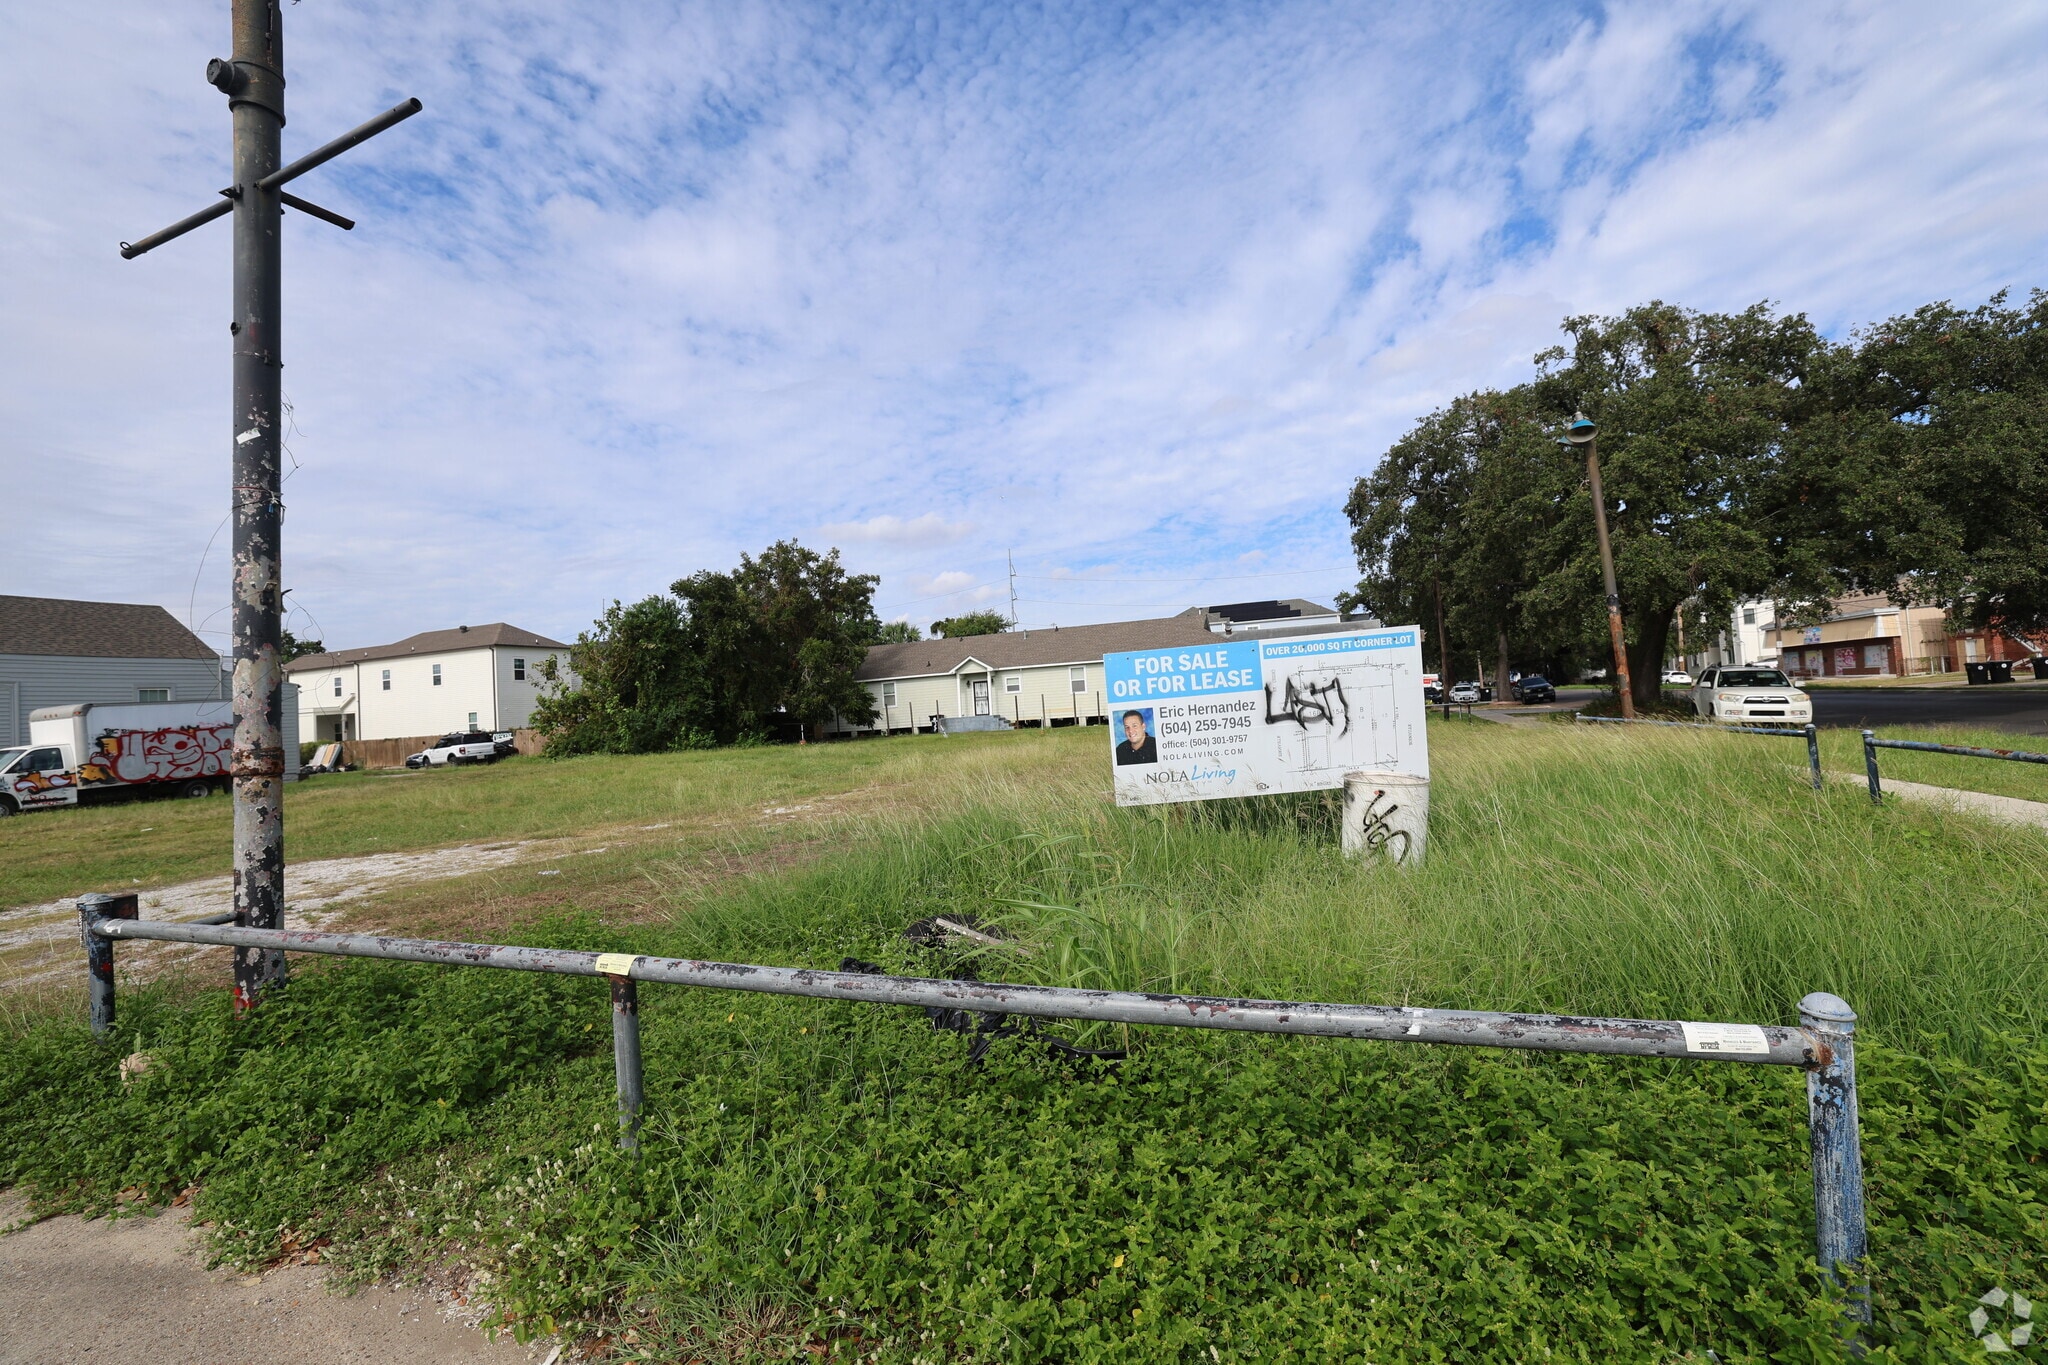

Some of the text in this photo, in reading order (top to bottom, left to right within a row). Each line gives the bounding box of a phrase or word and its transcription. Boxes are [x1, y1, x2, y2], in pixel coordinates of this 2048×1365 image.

[1266, 635, 1412, 656] OVER 20,000 SQ FT CORNER LOT
[1134, 651, 1229, 675] FOR SALE
[1113, 679, 1142, 697] OR
[1146, 675, 1186, 694] FOR
[1191, 669, 1254, 691] LEASE
[1160, 700, 1256, 719] Eric Hernandez
[1161, 716, 1252, 737] (504) 259-7945
[1162, 734, 1248, 749] office: (504) 301-9757
[1163, 748, 1244, 761] NOLALIVING.COM
[1146, 764, 1236, 784] NOLA Living
